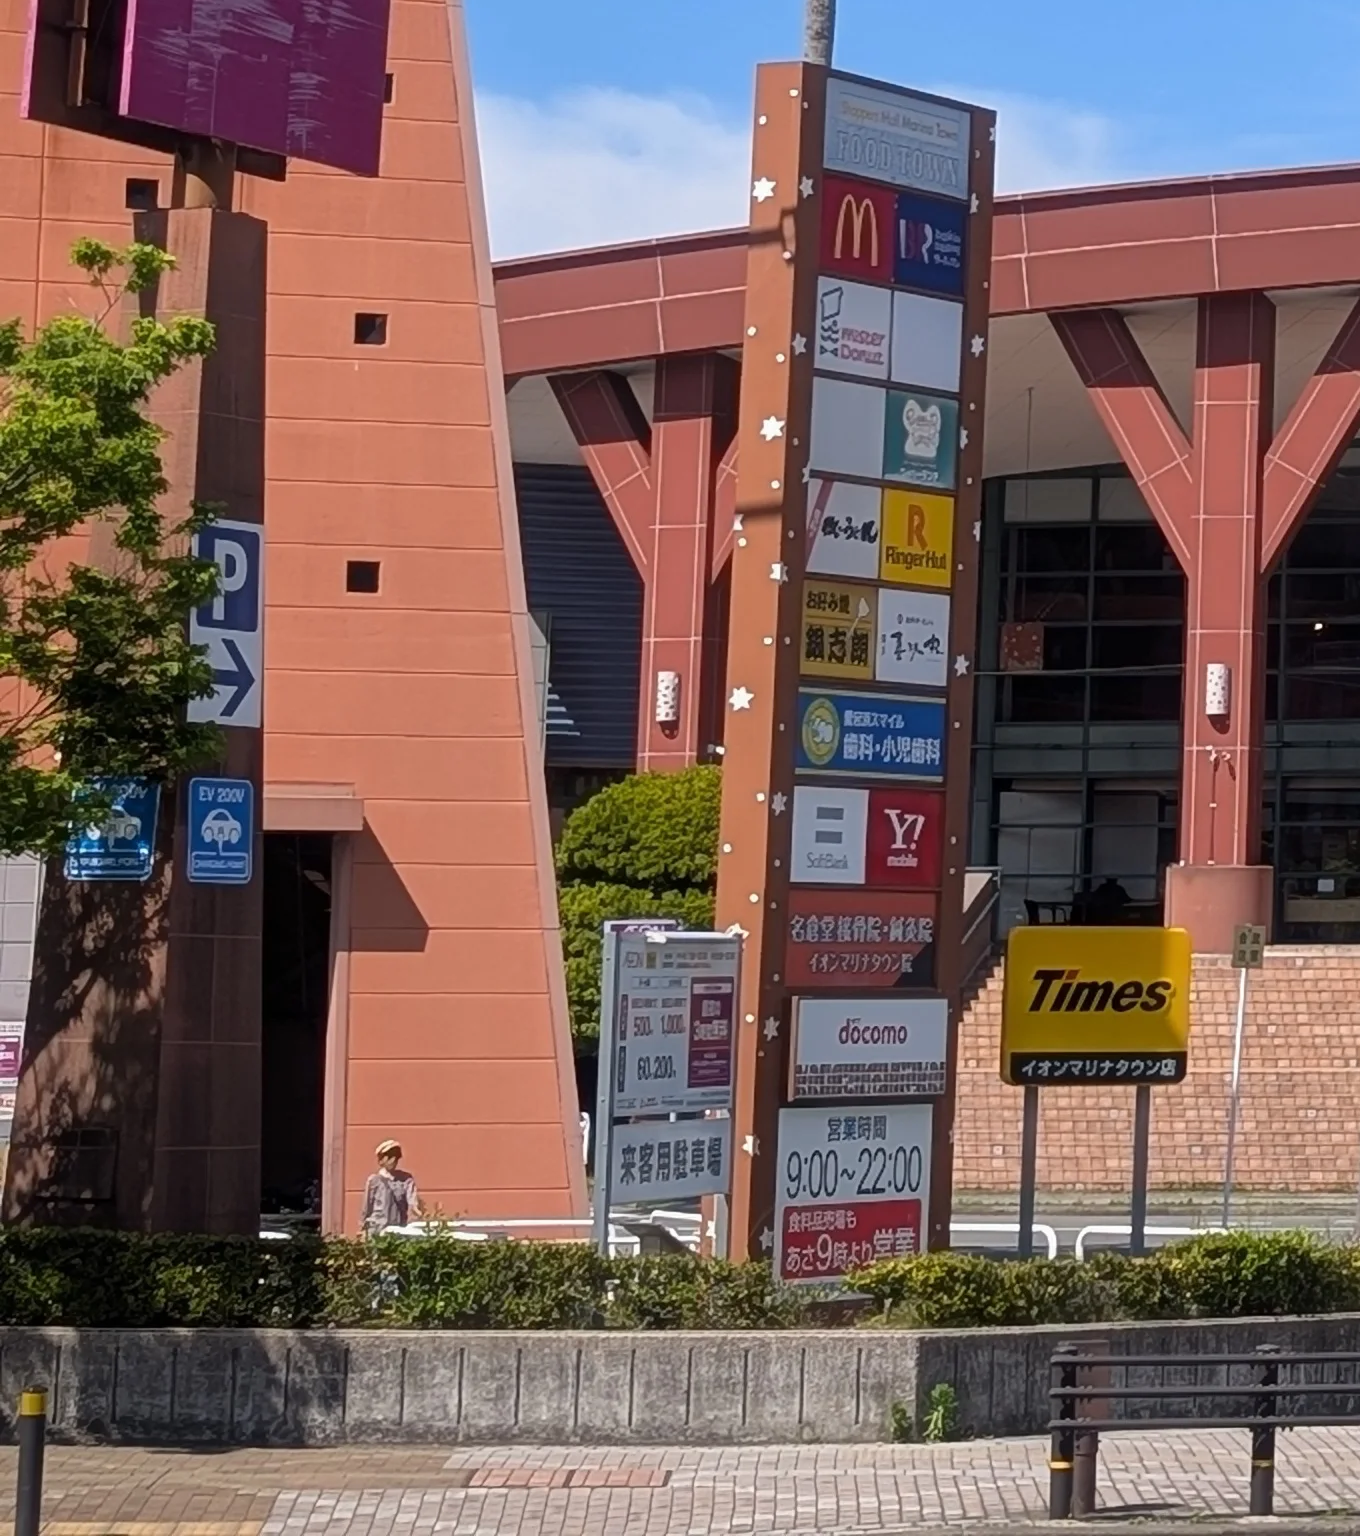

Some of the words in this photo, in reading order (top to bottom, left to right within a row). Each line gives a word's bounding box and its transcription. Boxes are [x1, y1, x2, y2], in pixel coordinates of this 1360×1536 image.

[837, 130, 892, 171] FOOD
[896, 144, 960, 188] TOWN
[212, 539, 248, 621] P
[843, 732, 940, 765] 歯科・小児歯科
[199, 786, 213, 802] EV
[884, 808, 925, 850] Y!
[809, 952, 913, 973] イオンマリナタウン院
[1029, 969, 1172, 1012] Times
[838, 1018, 908, 1045] docomo
[1022, 1058, 1176, 1077] イオンマリナタウン店
[827, 1115, 887, 1142] 営業時間
[620, 1136, 722, 1186] 来客用駐車場
[788, 1209, 857, 1233] 食料品売場も
